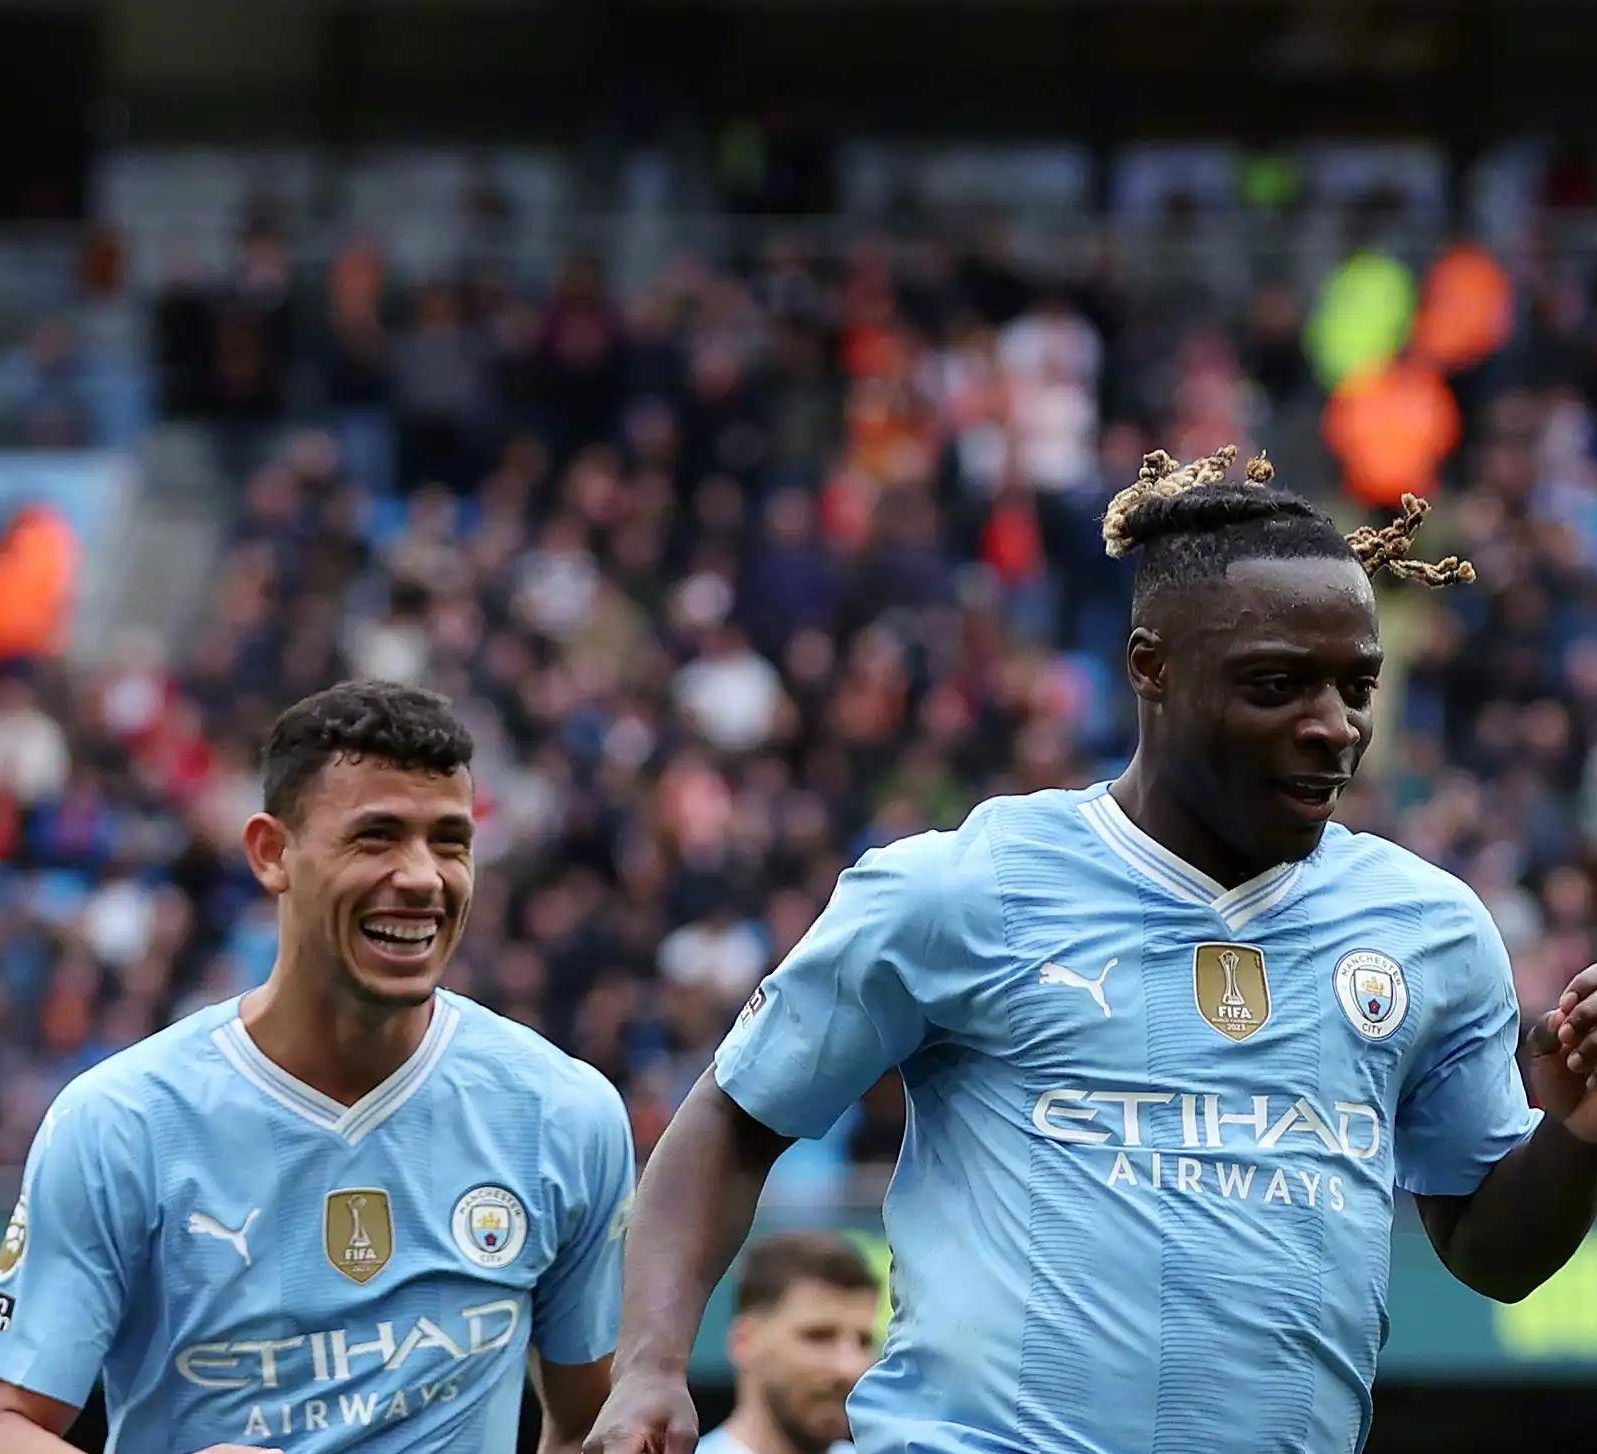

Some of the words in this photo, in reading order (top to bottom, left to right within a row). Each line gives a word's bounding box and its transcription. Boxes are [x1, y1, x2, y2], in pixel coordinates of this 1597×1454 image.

[1342, 955, 1402, 986] MANCHESTER
[1217, 1006, 1252, 1019] FIFA
[1361, 1023, 1383, 1034] CITY
[1032, 1089, 1381, 1159] ETIHAD
[1106, 1151, 1346, 1212] AIRWAYS
[344, 1248, 377, 1260] FIFA
[175, 1299, 519, 1389] ETIHAD
[243, 1378, 458, 1439] AIRWAYS
